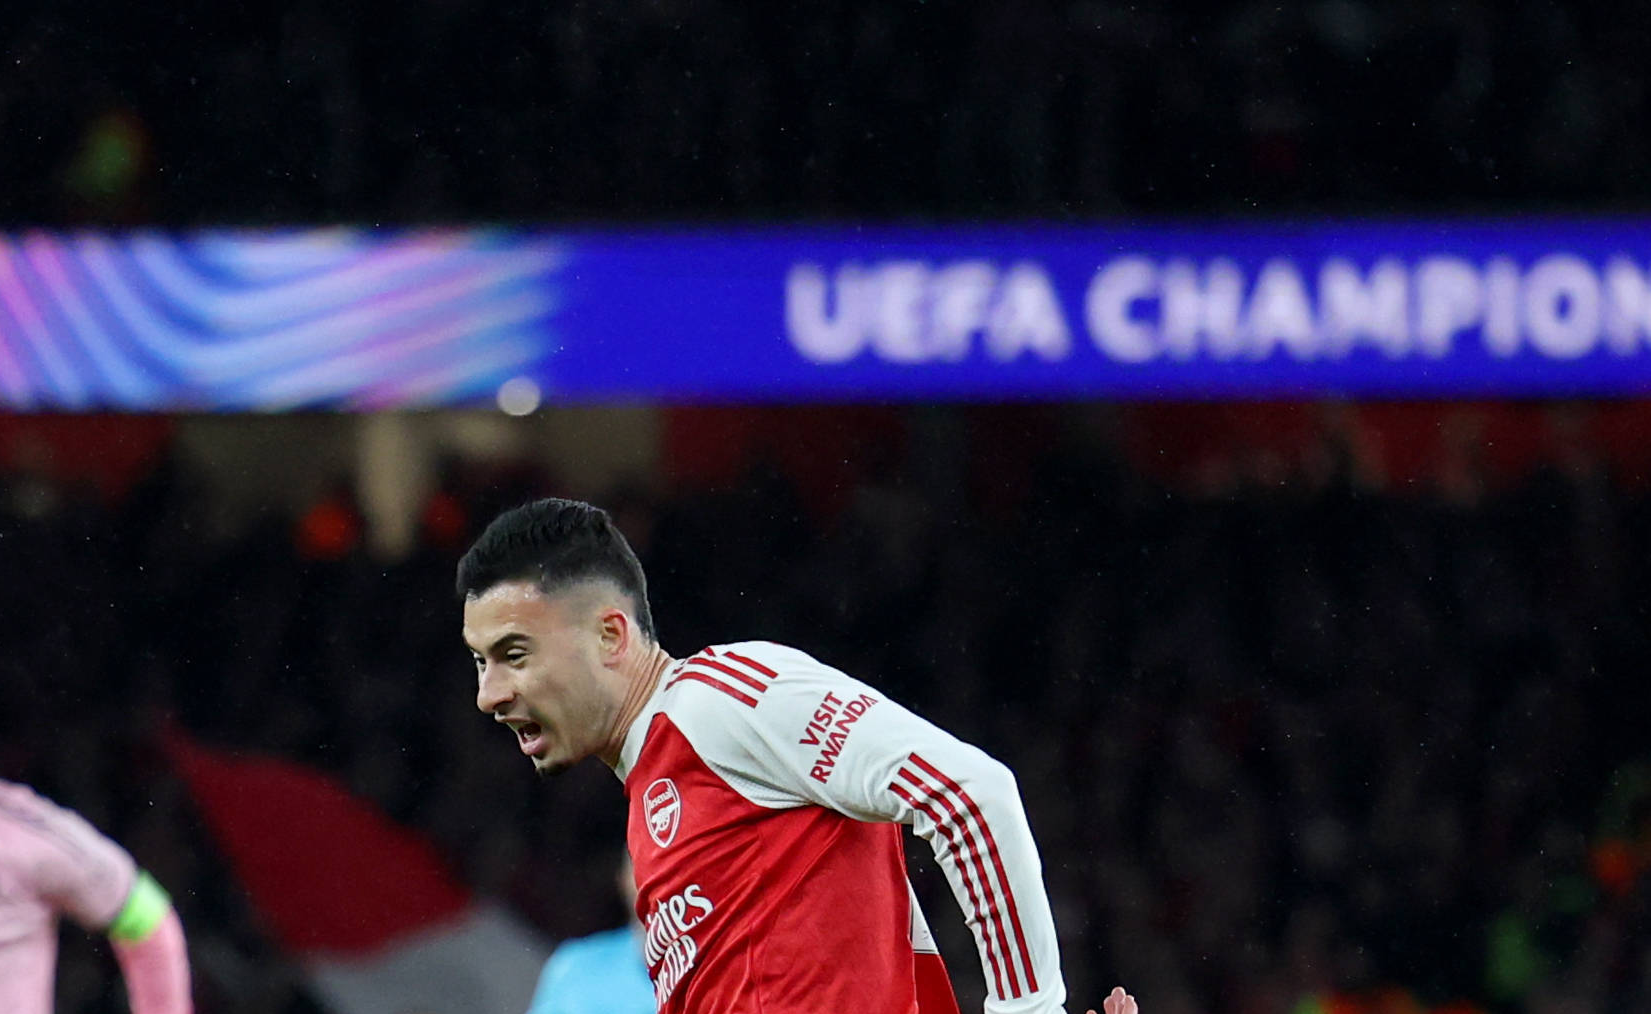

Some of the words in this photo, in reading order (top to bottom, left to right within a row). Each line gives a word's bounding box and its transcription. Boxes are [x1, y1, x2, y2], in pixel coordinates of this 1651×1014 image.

[786, 262, 1070, 362] UEFA
[799, 691, 843, 745] VISIT
[809, 693, 879, 784] RWANDA
